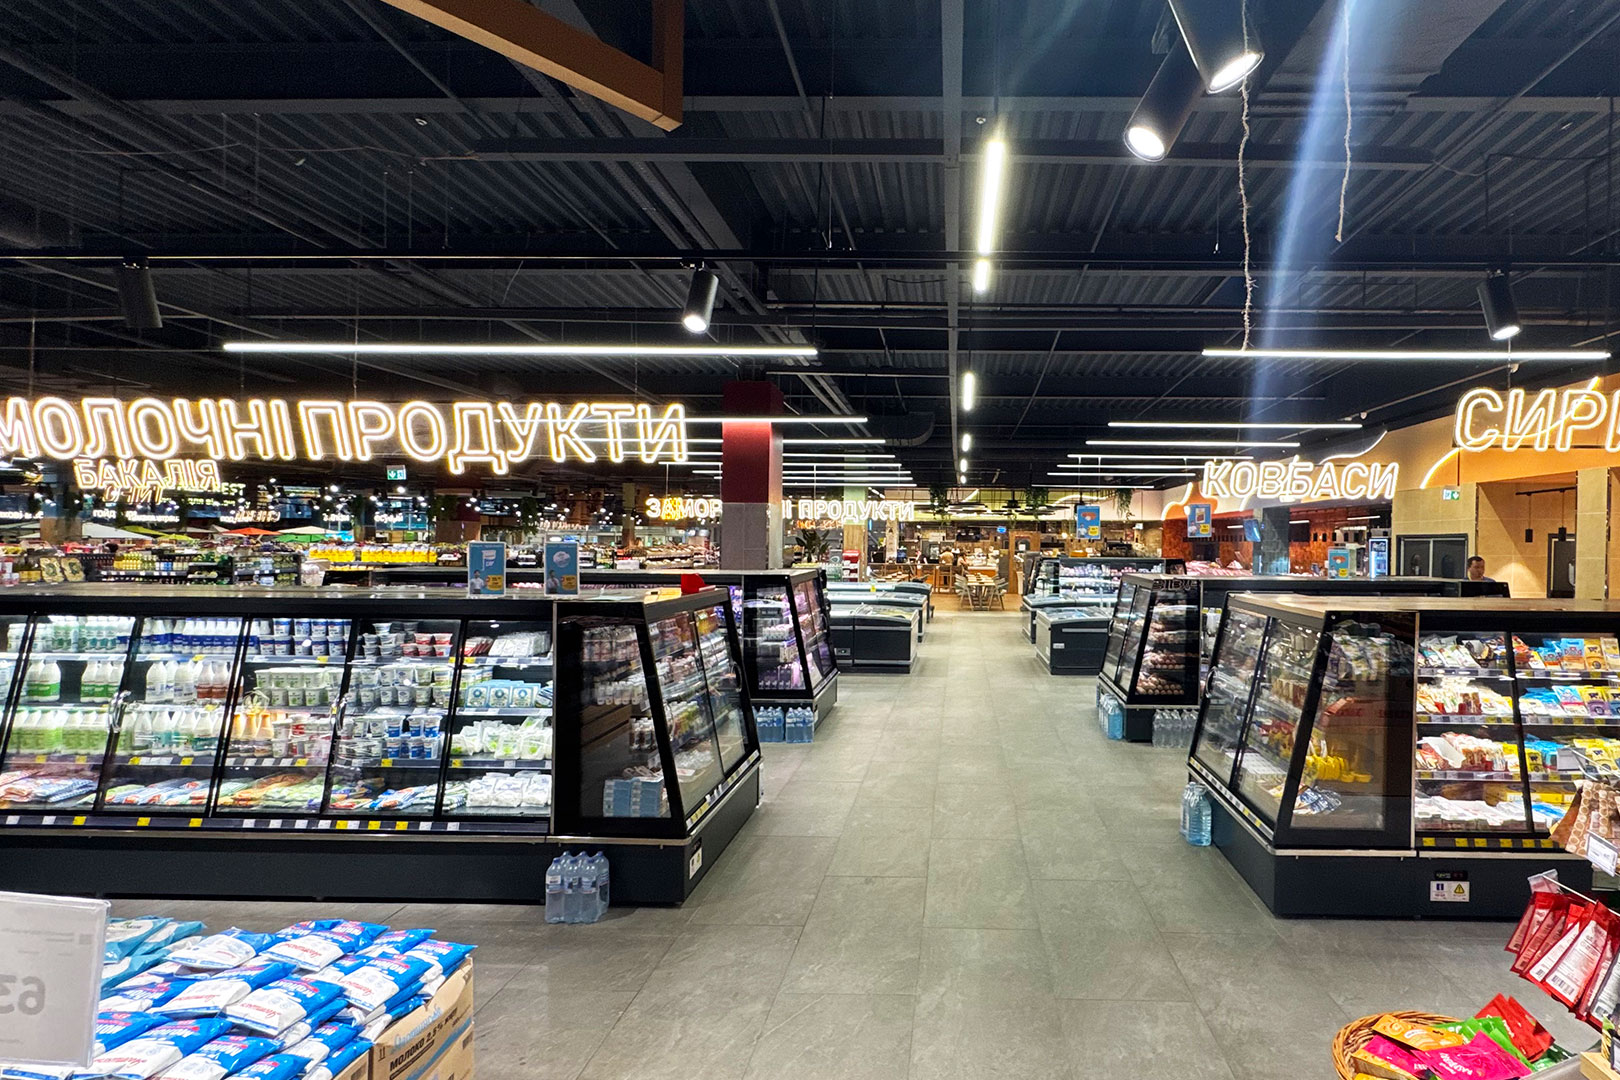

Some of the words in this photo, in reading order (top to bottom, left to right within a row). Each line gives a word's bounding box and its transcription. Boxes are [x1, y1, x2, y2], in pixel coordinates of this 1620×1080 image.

[0, 397, 297, 460] МОЛОЧНІ
[298, 400, 689, 475] ПРОДУКТИ
[73, 458, 222, 490] БАКАЛІЯ
[1201, 460, 1400, 500] КОВБАСИ
[797, 499, 915, 523] ПРОДУКТИ
[390, 1037, 425, 1072] МОЛОКО
